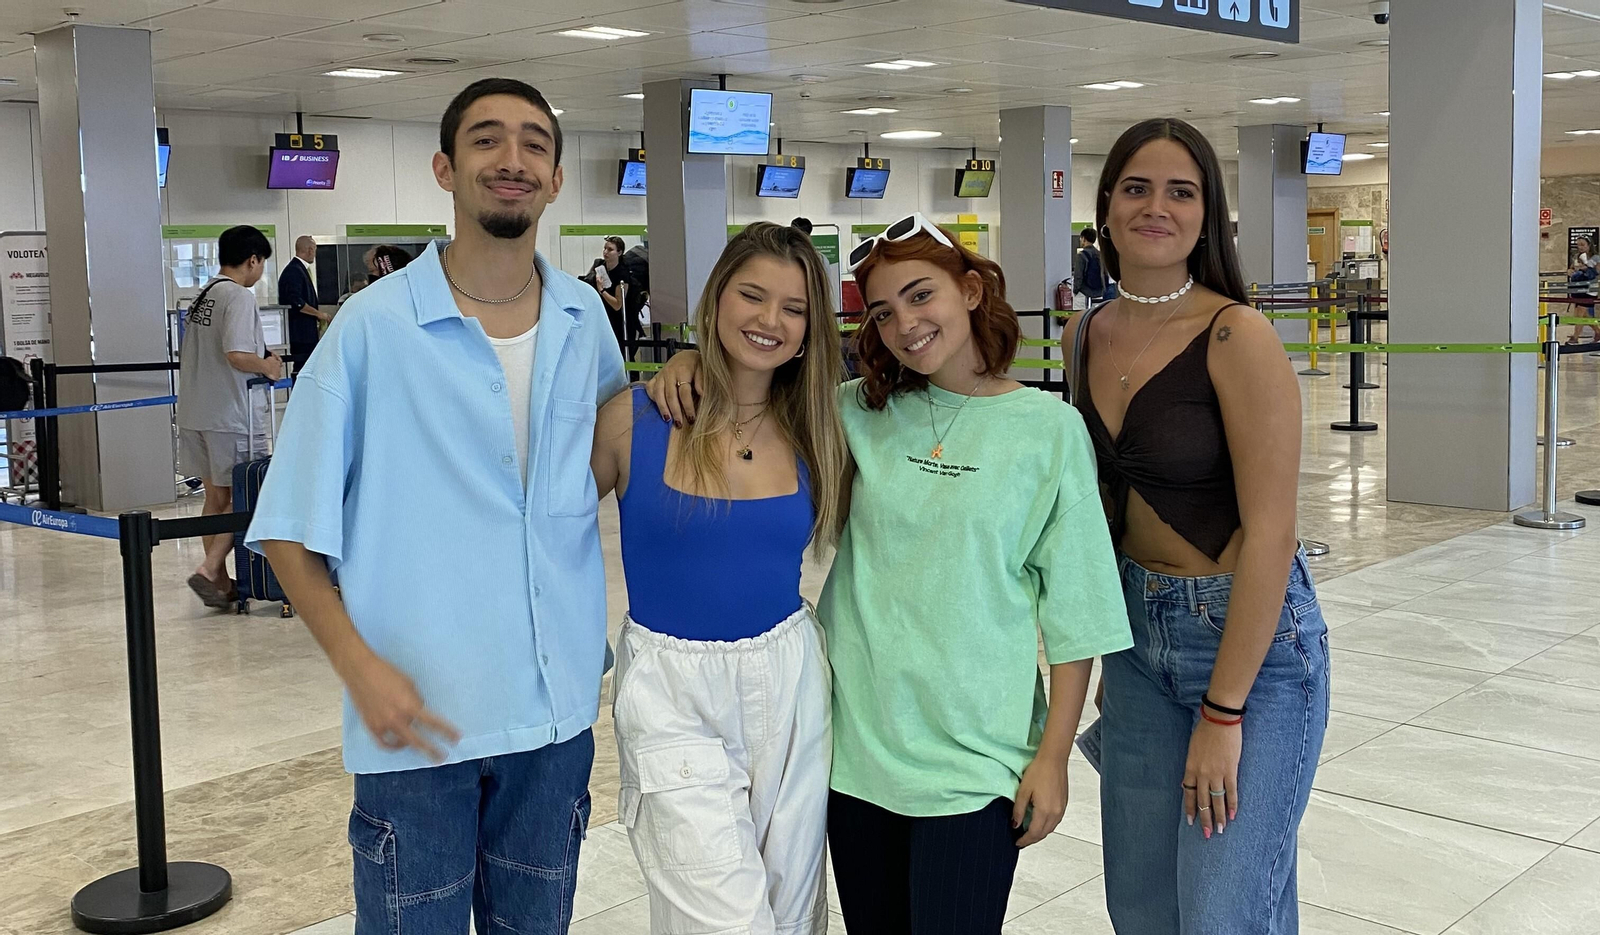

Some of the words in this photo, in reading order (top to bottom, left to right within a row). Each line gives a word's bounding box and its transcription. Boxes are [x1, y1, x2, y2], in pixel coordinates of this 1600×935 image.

[314, 134, 324, 150] 5
[790, 156, 797, 167] 8
[877, 158, 883, 170] 9
[981, 160, 991, 170] 10
[7, 250, 45, 259] VOLOTEA
[919, 466, 938, 474] Vincent
[42, 514, 69, 529] AirEuropa
